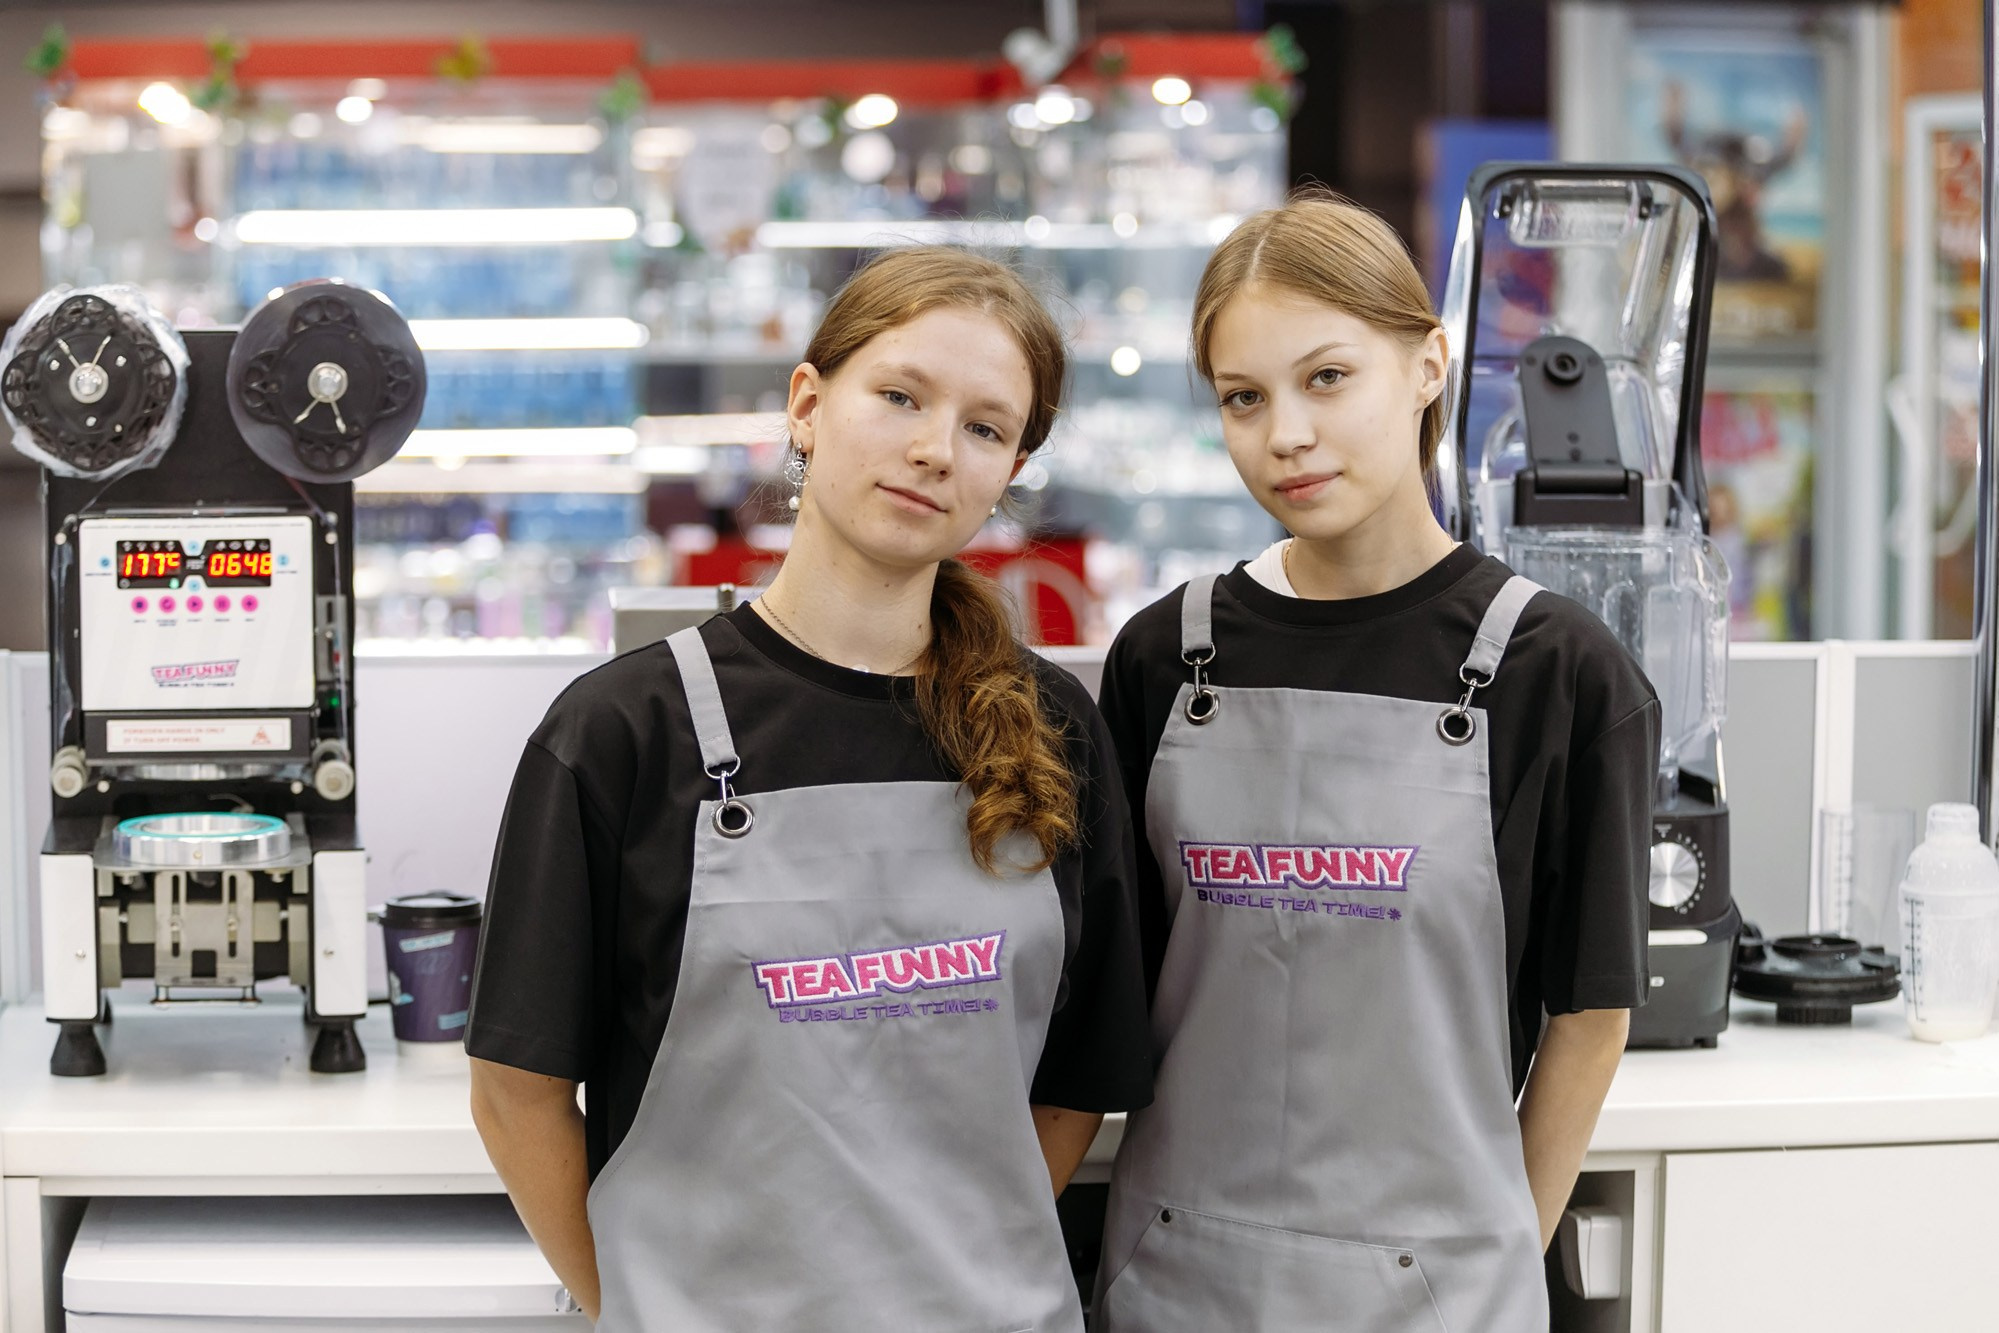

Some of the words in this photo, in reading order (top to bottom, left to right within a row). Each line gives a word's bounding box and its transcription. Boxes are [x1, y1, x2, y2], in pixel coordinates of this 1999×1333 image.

[153, 666, 182, 681] TEA
[184, 662, 237, 679] FUNNY
[1184, 844, 1267, 886] TEA
[1261, 845, 1416, 890] FUNNY
[1197, 889, 1275, 909] BUBBLE
[1278, 898, 1318, 913] TEA
[1322, 902, 1385, 920] TIME!
[755, 958, 859, 1005] TEA
[849, 933, 1003, 994] FUNNY
[779, 1006, 868, 1023] BUBBLE
[871, 1003, 914, 1019] TEA
[917, 999, 981, 1016] TIME!
